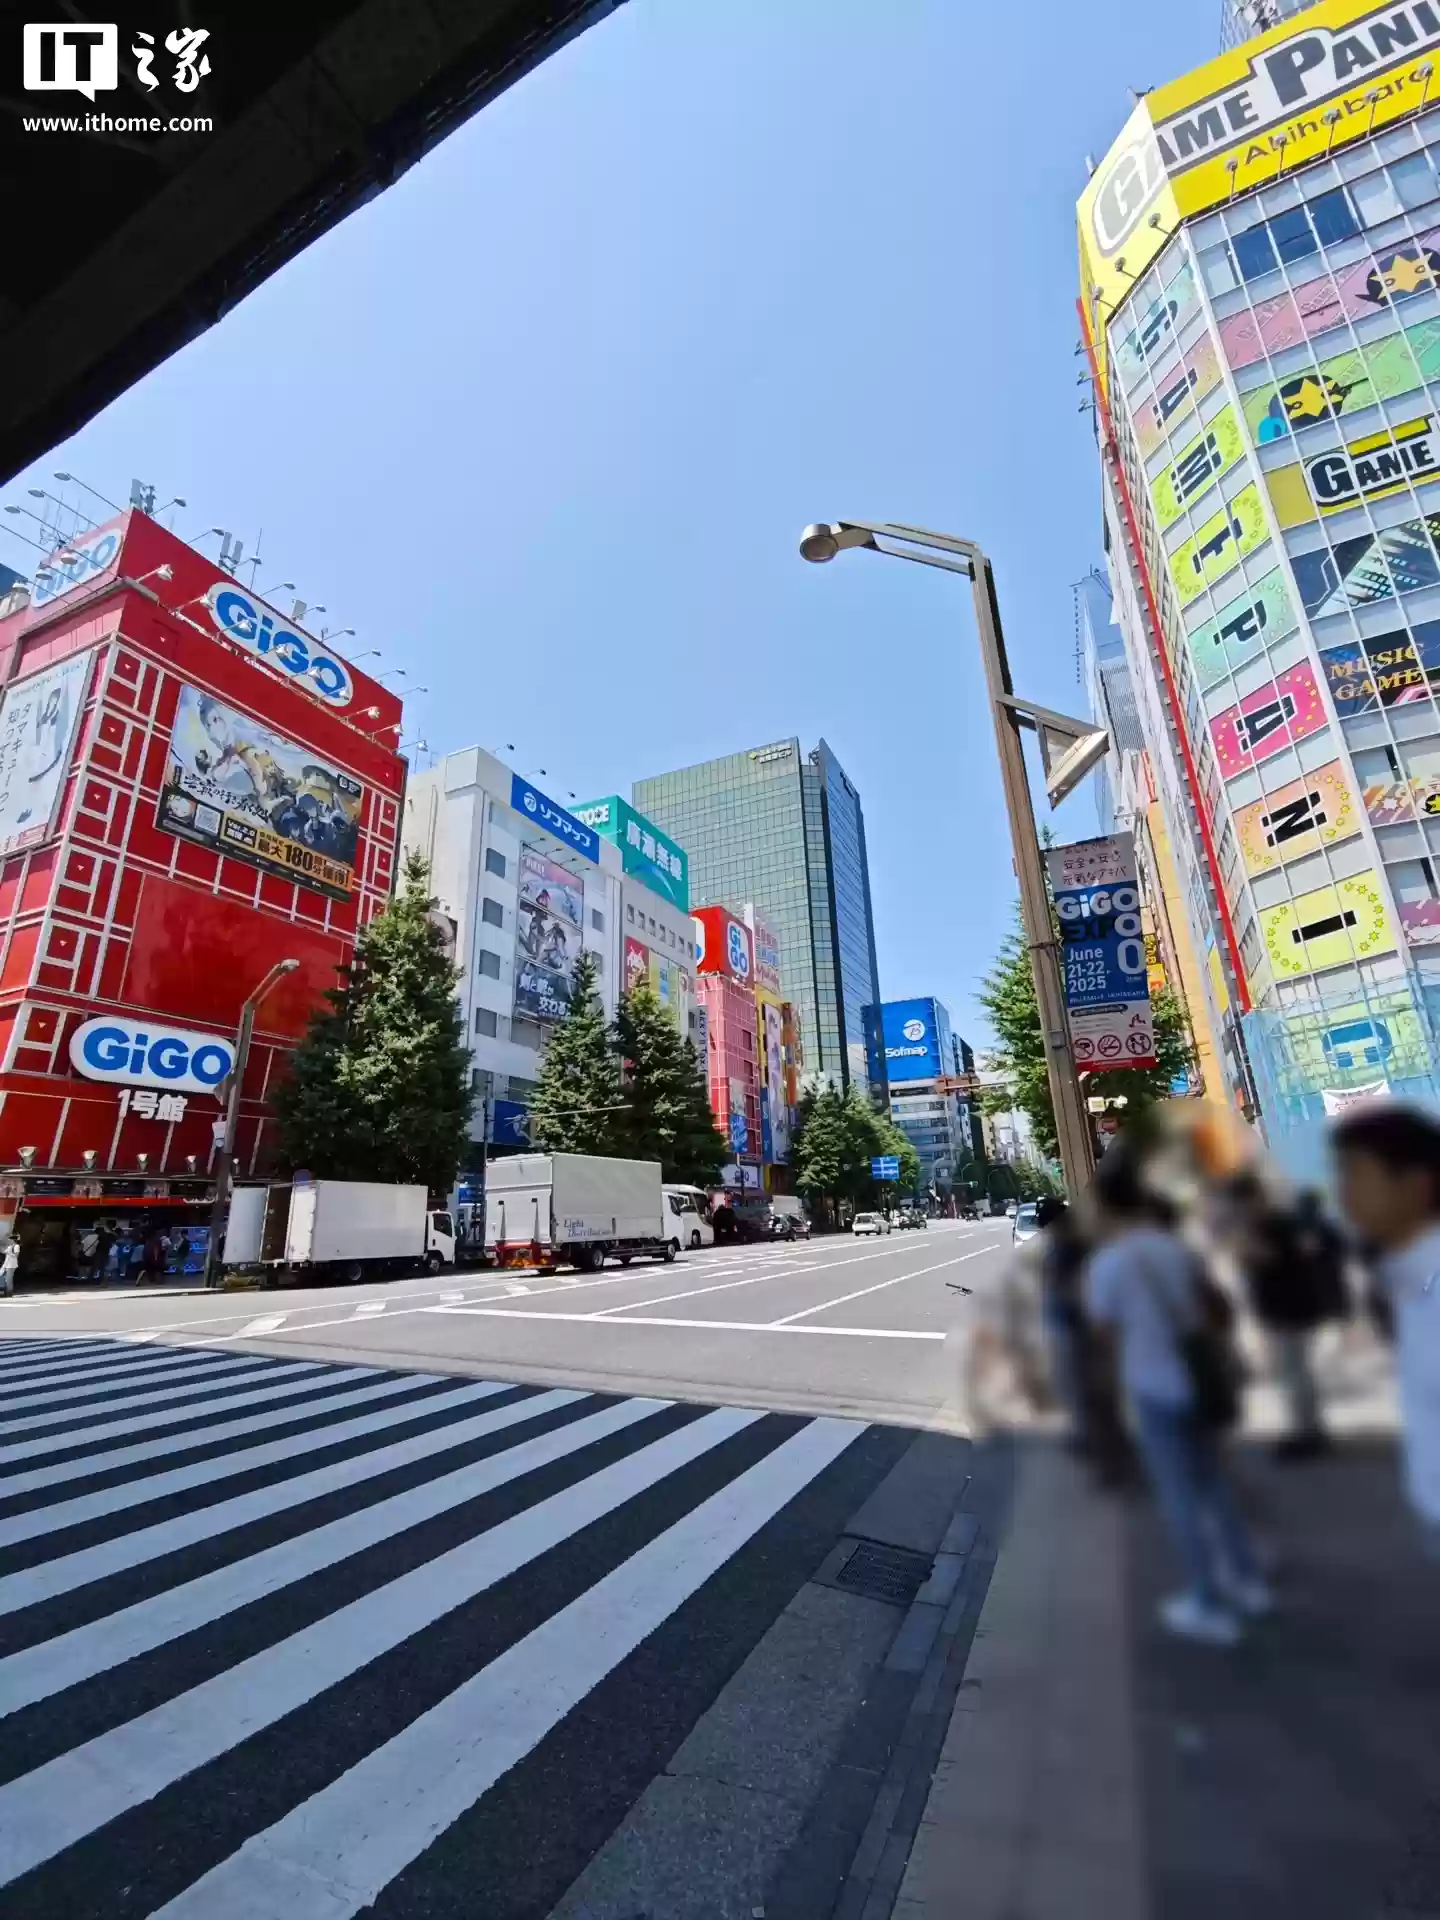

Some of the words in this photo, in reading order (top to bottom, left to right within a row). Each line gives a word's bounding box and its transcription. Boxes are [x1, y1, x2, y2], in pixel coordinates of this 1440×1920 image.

[1263, 0, 1440, 107] PANI
[1310, 440, 1435, 498] GAME
[216, 591, 346, 699] GiGO
[1330, 643, 1424, 680] MUSIC
[1334, 667, 1422, 700] GAME
[540, 793, 591, 848] ソフマップ
[1055, 887, 1141, 920] GiGO
[1067, 947, 1104, 962] June
[1068, 975, 1107, 994] 2025
[83, 1027, 231, 1085] GiGO
[884, 1046, 928, 1058] Sofmap
[117, 1089, 188, 1123] 1号館
